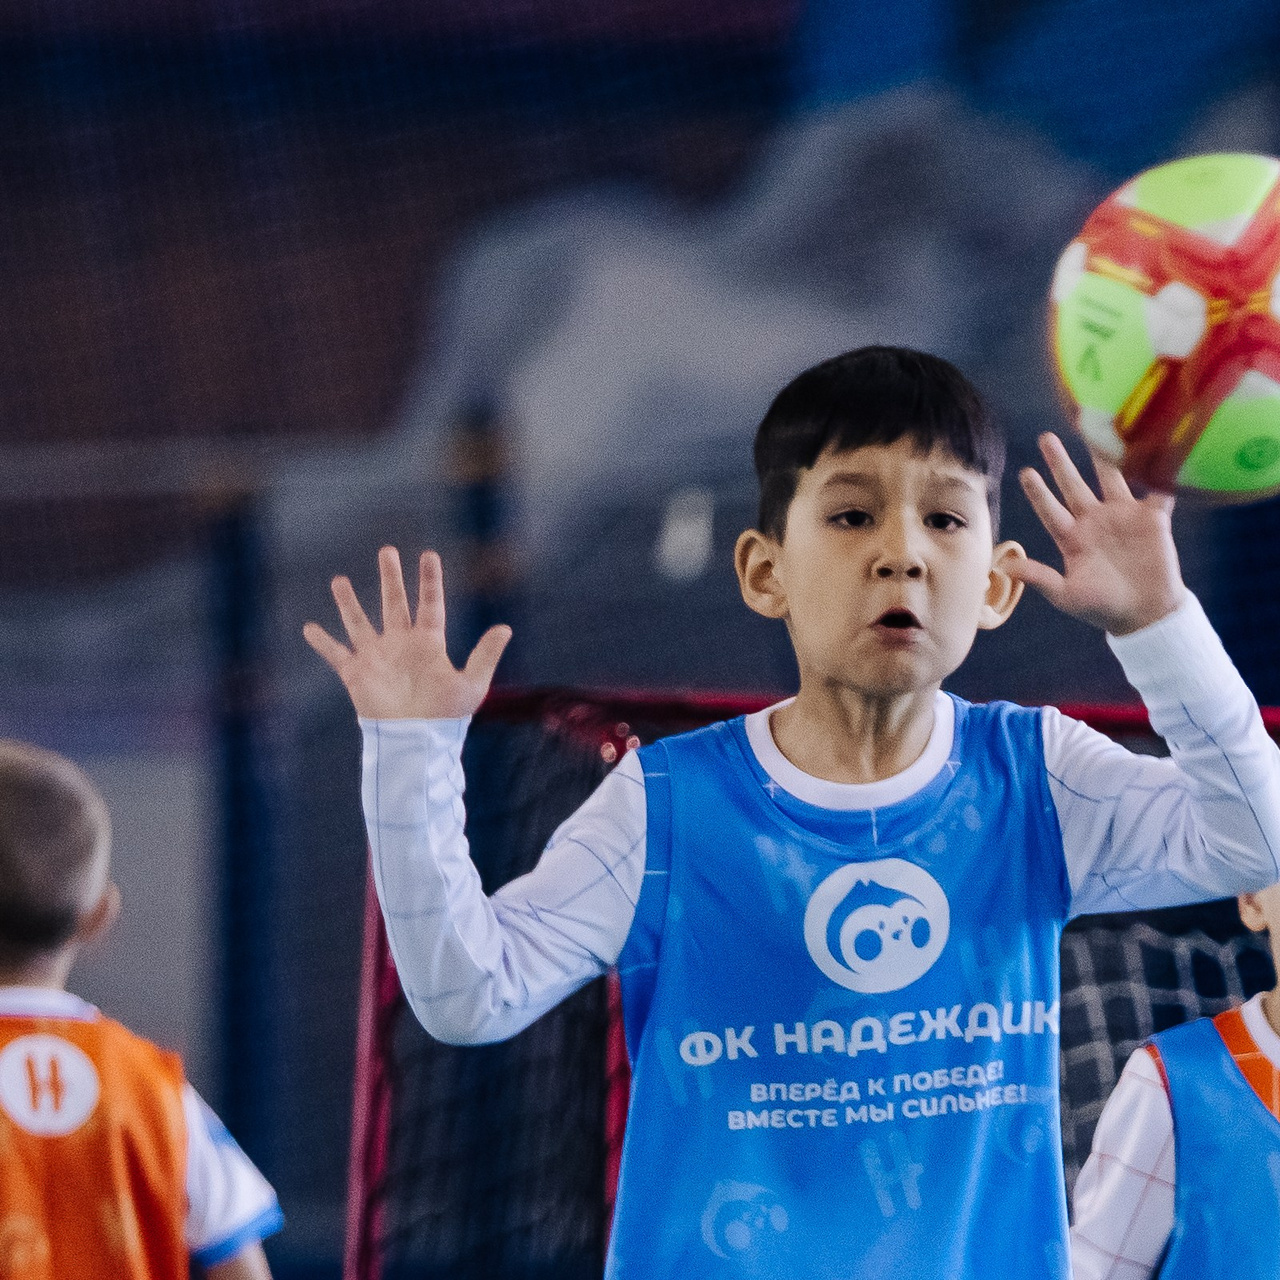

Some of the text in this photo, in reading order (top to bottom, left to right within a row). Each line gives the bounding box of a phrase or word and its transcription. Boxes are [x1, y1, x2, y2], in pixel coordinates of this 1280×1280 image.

[679, 1000, 1060, 1067] ФК НАДЕЖДИК
[728, 1083, 1028, 1131] ВМЕСТЕ МЫ СИЛЬНЕЕ!
[750, 1078, 860, 1104] ВПЕРЁД
[868, 1079, 886, 1096] К
